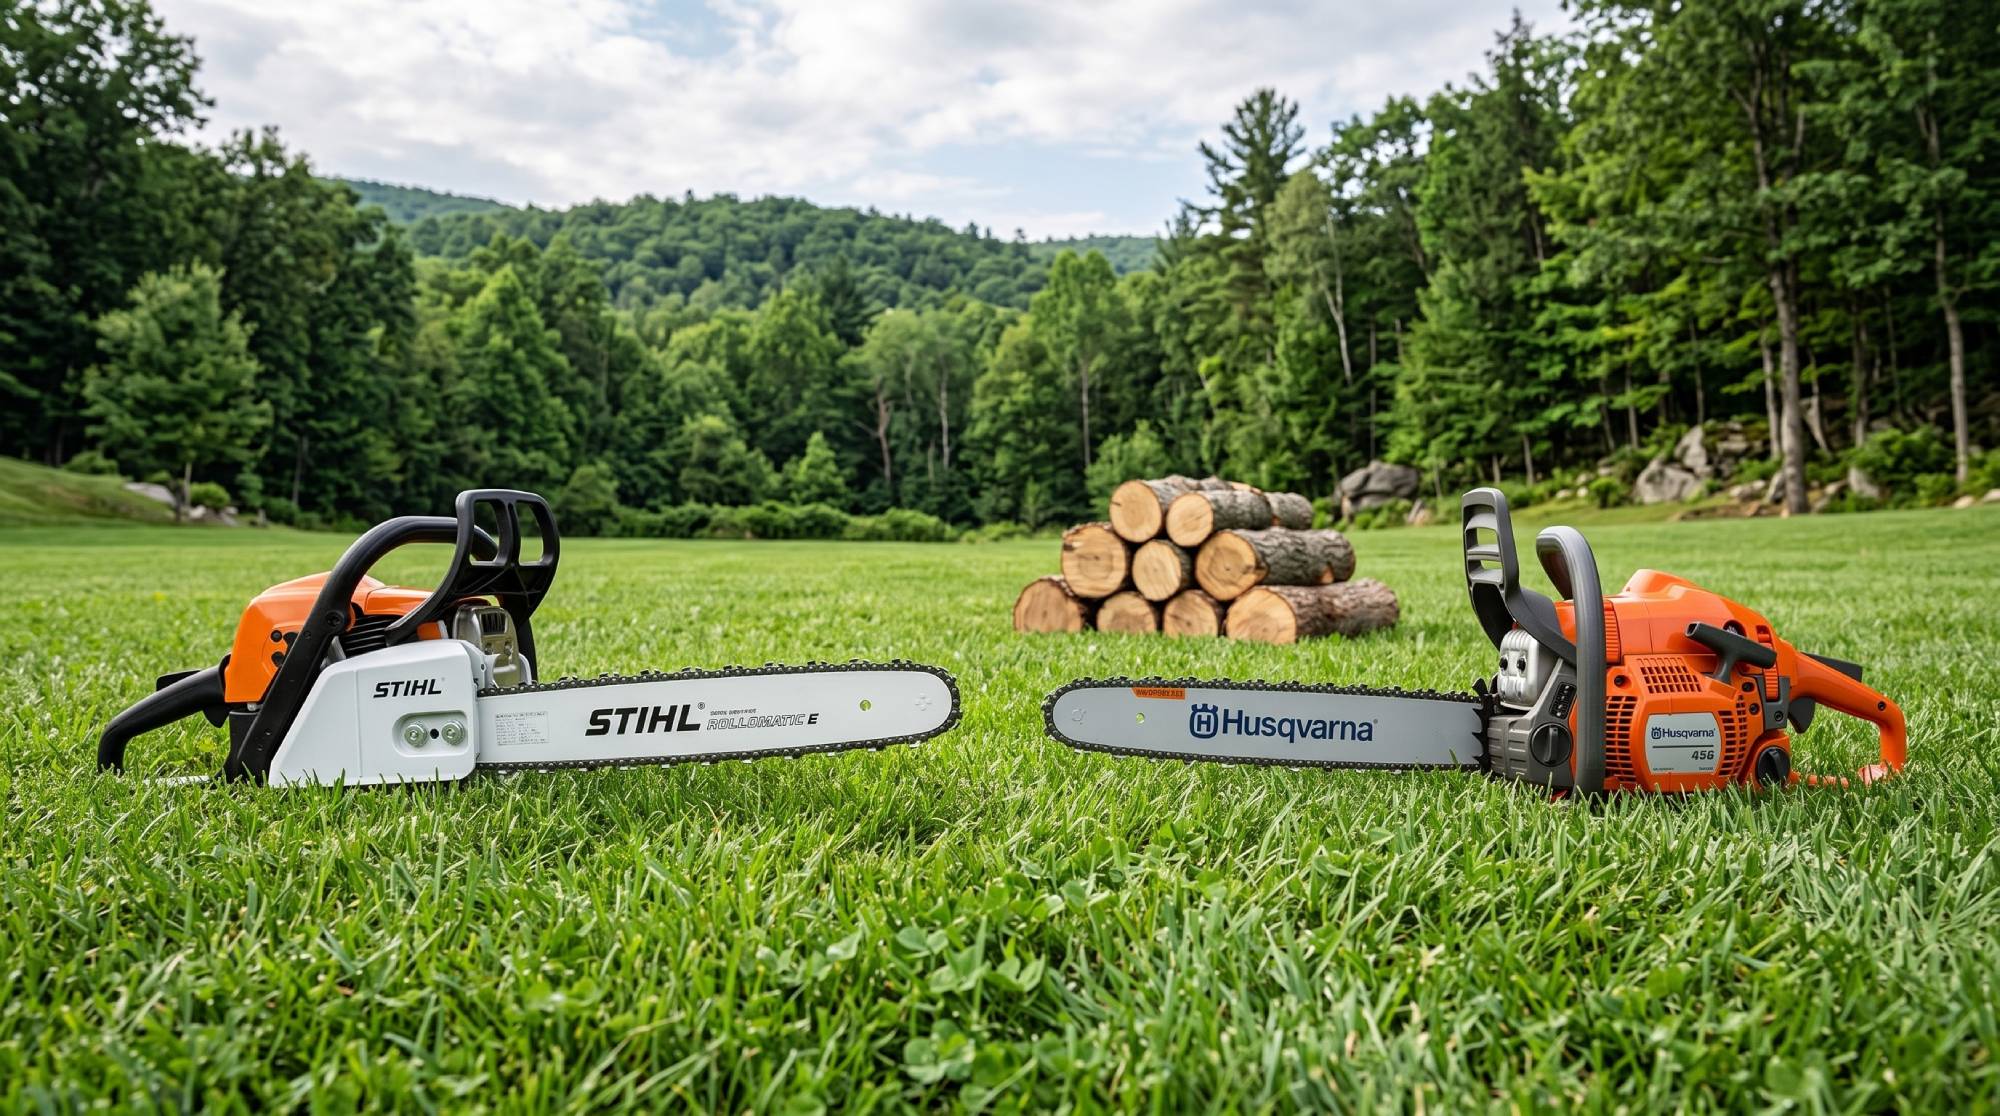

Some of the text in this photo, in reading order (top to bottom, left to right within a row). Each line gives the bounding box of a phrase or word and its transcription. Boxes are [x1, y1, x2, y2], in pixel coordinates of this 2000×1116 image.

[373, 679, 442, 699] STIHL
[707, 713, 819, 730] ROLLOMATIC E
[1222, 709, 1373, 743] Husqvarna
[1662, 728, 1714, 739] Husqvarna
